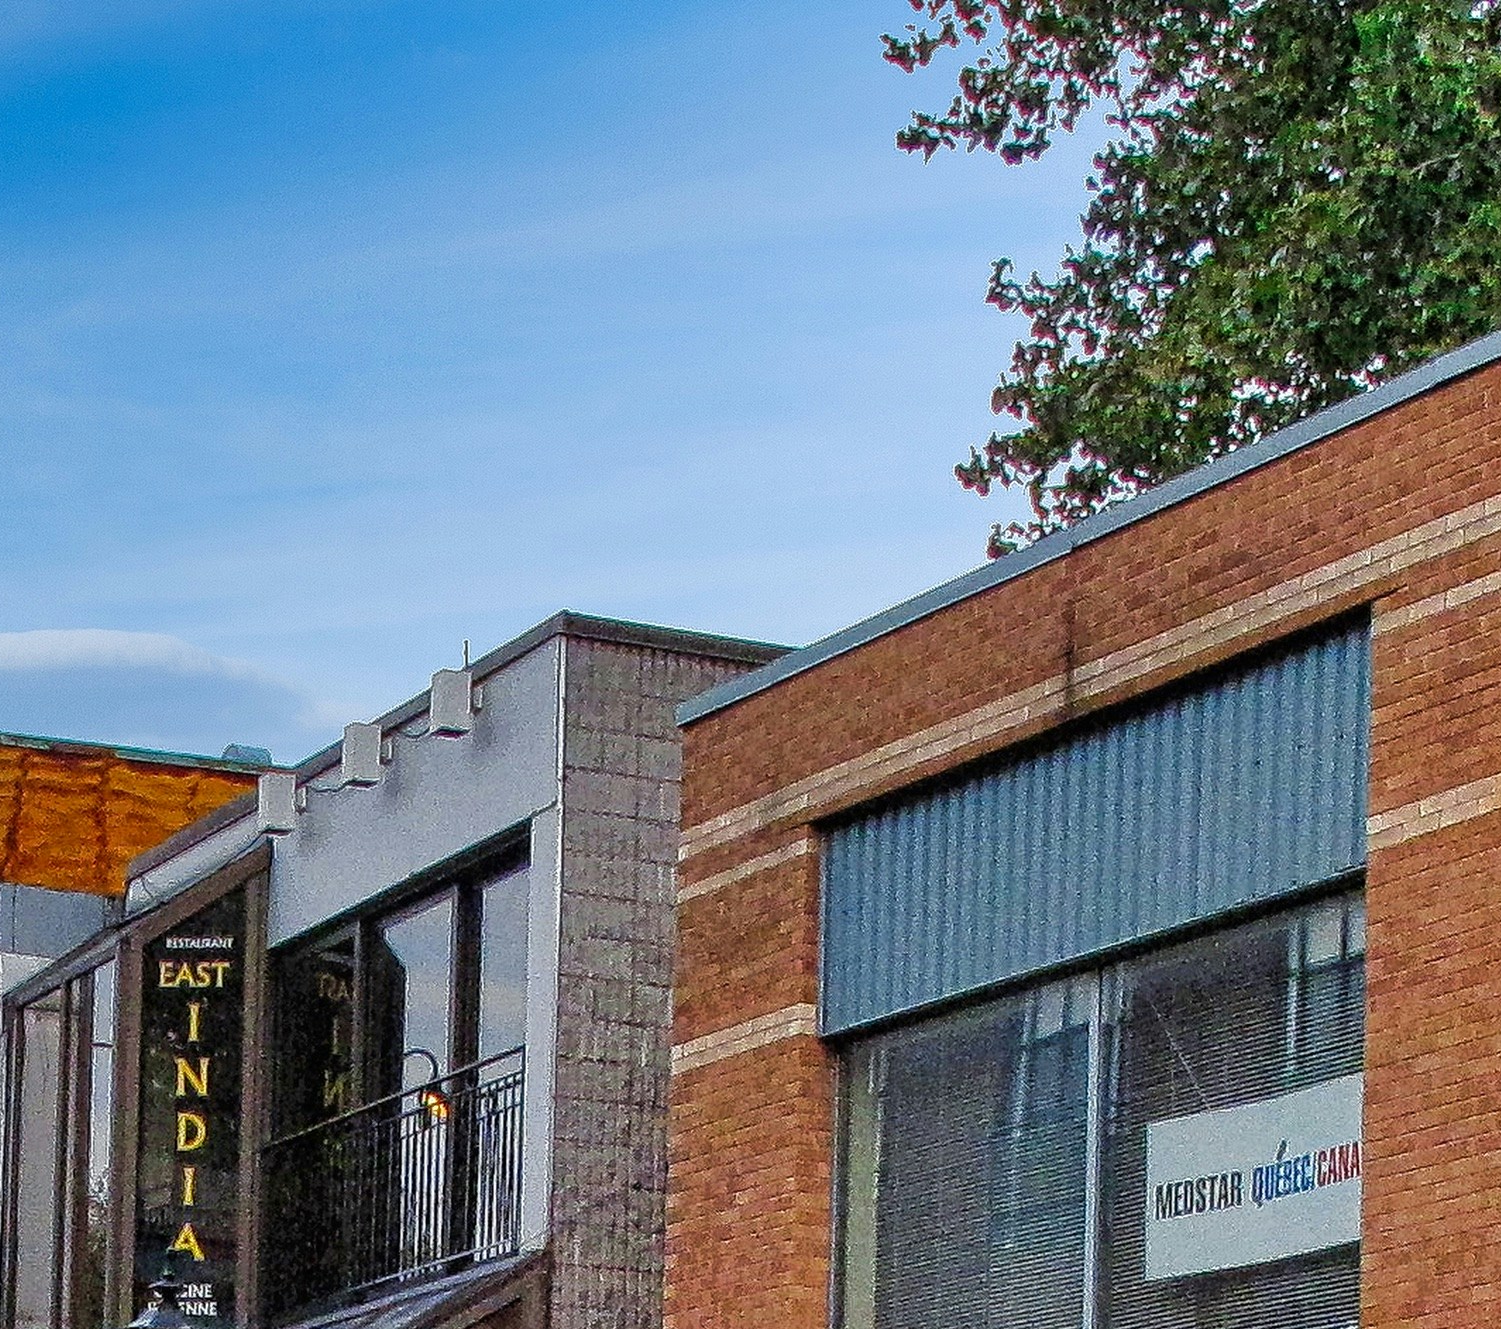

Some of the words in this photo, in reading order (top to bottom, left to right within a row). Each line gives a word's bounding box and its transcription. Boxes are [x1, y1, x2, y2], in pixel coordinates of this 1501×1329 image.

[166, 936, 235, 950] RESTAURANT
[158, 961, 231, 988] EAST
[171, 1001, 211, 1262] INDIA
[1153, 1170, 1244, 1220] MEDSTAR
